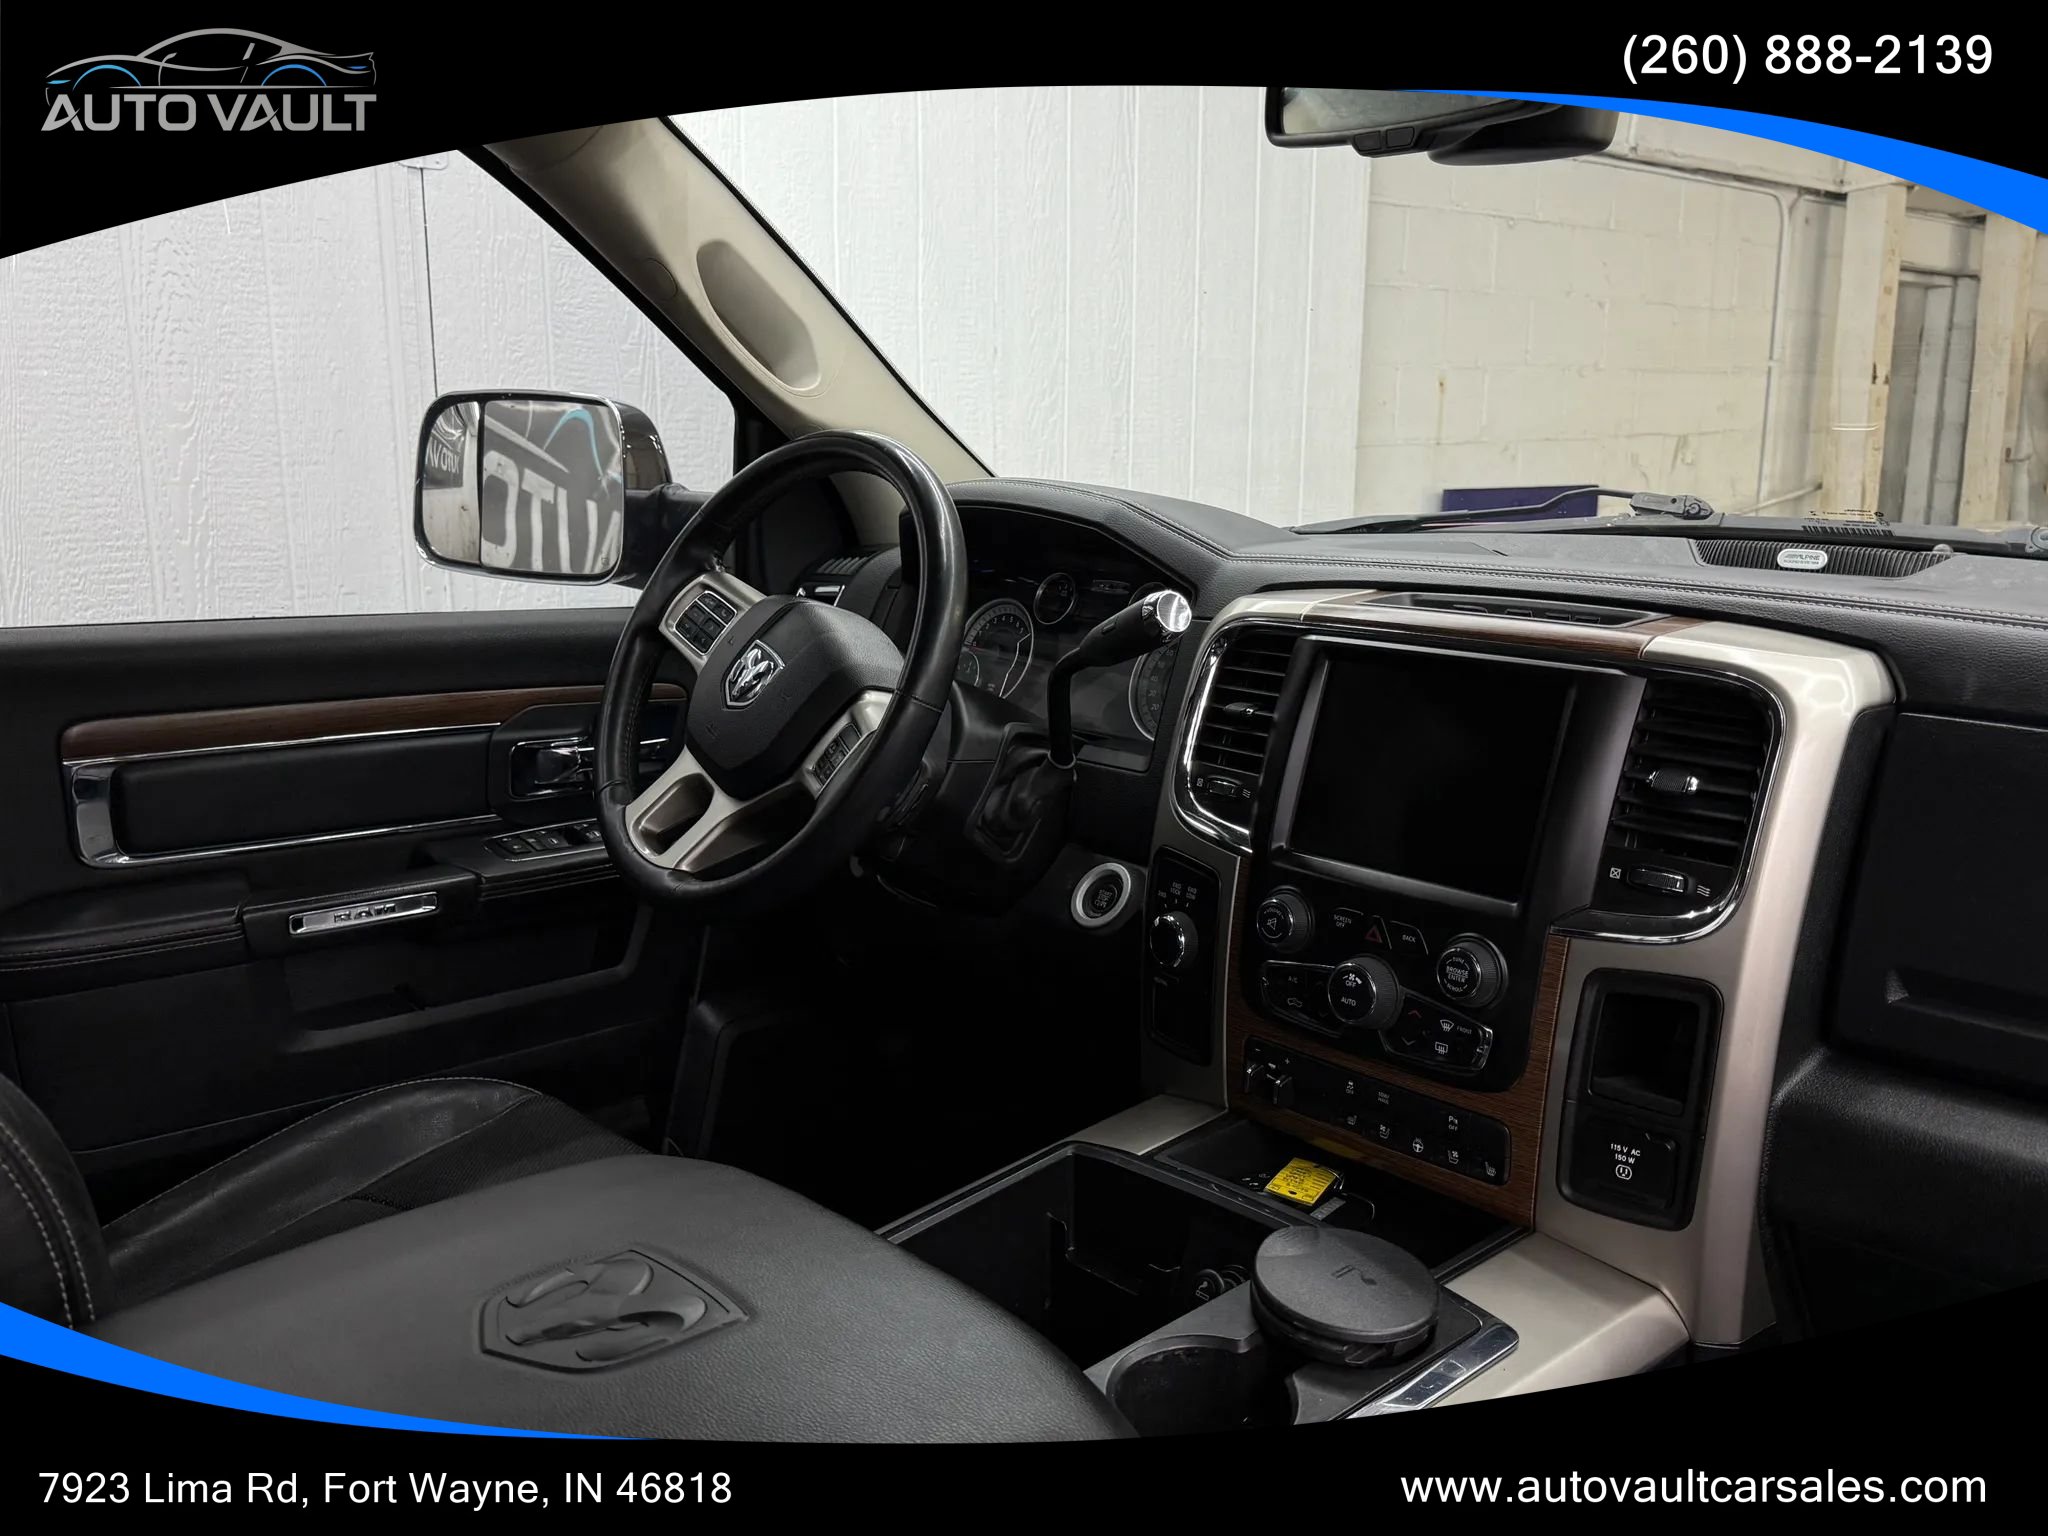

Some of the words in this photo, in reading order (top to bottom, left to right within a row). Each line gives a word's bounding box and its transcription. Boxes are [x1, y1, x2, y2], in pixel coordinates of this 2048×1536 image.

[1341, 996, 1357, 1007] AUTO
[1611, 1143, 1621, 1152] 115
[1631, 1148, 1641, 1157] AC
[1615, 1153, 1627, 1162] 150
[1628, 1156, 1636, 1164] W
